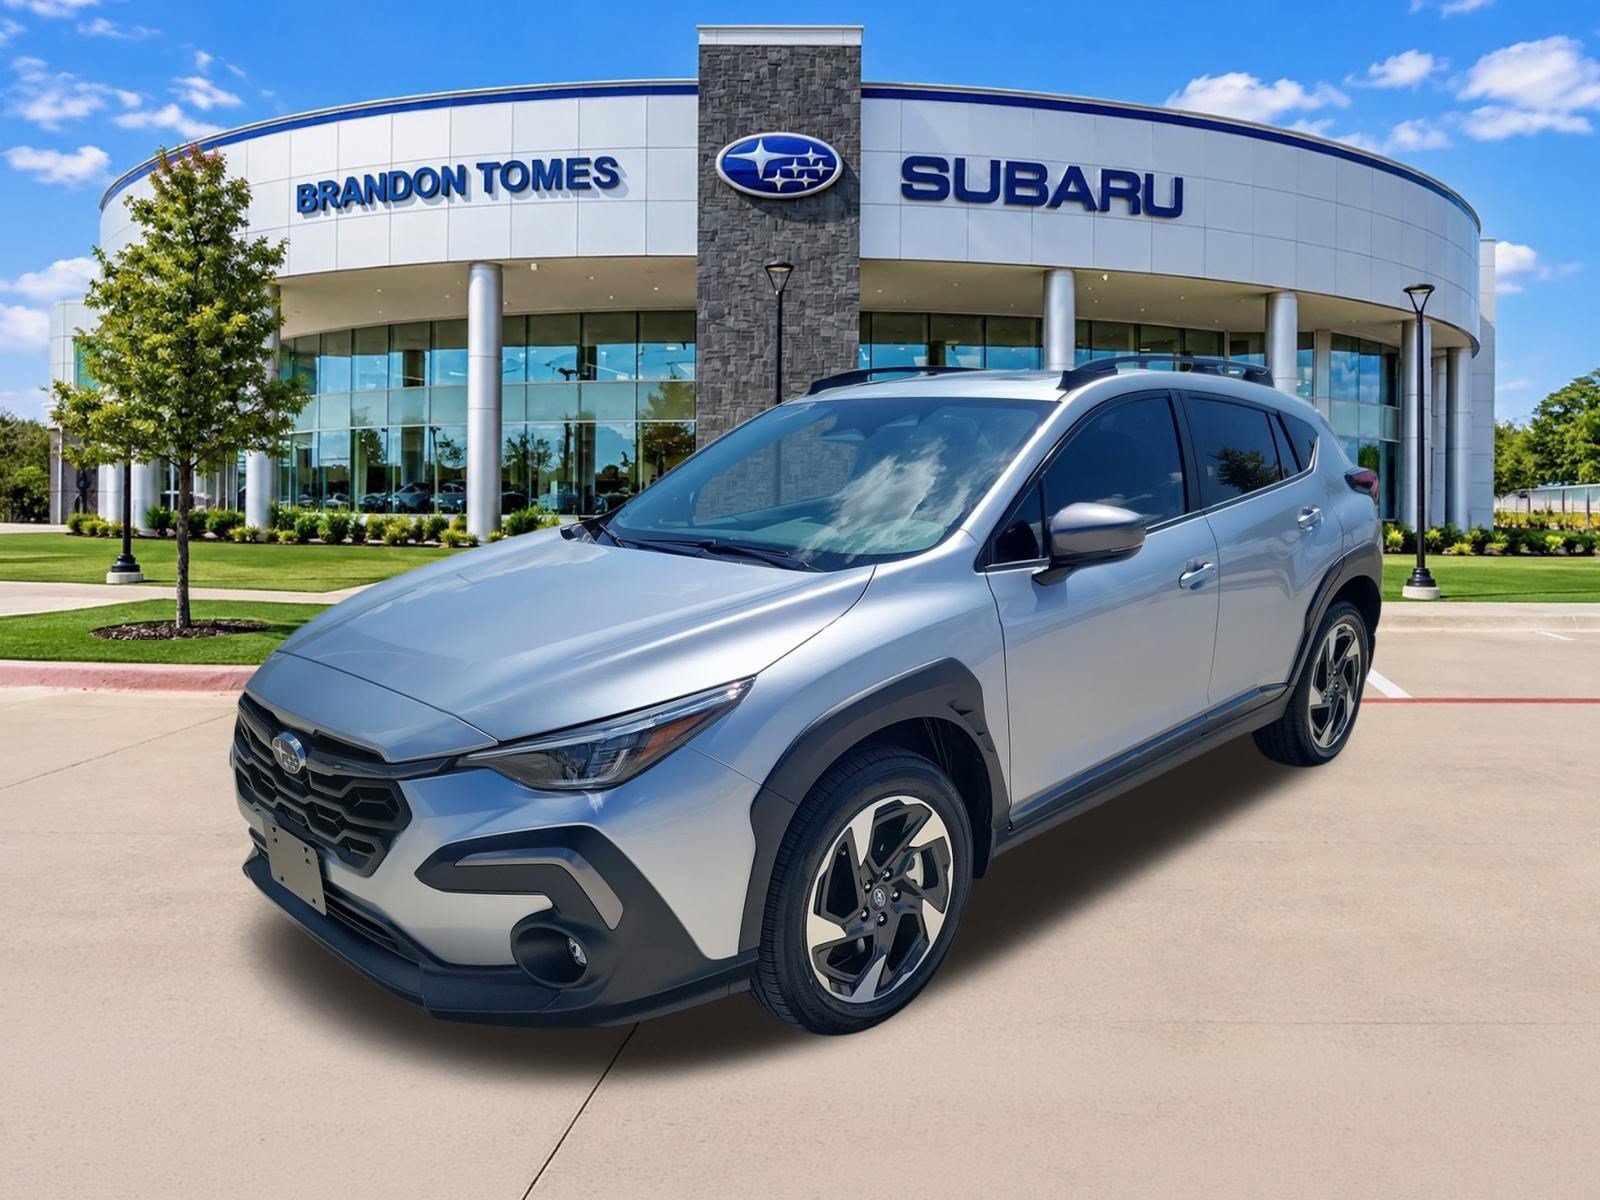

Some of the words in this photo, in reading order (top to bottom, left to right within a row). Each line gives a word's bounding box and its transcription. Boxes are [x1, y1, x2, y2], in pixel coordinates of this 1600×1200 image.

[296, 163, 466, 214] BRANDON
[476, 155, 620, 194] TOMES
[900, 155, 1184, 218] SUBARU
